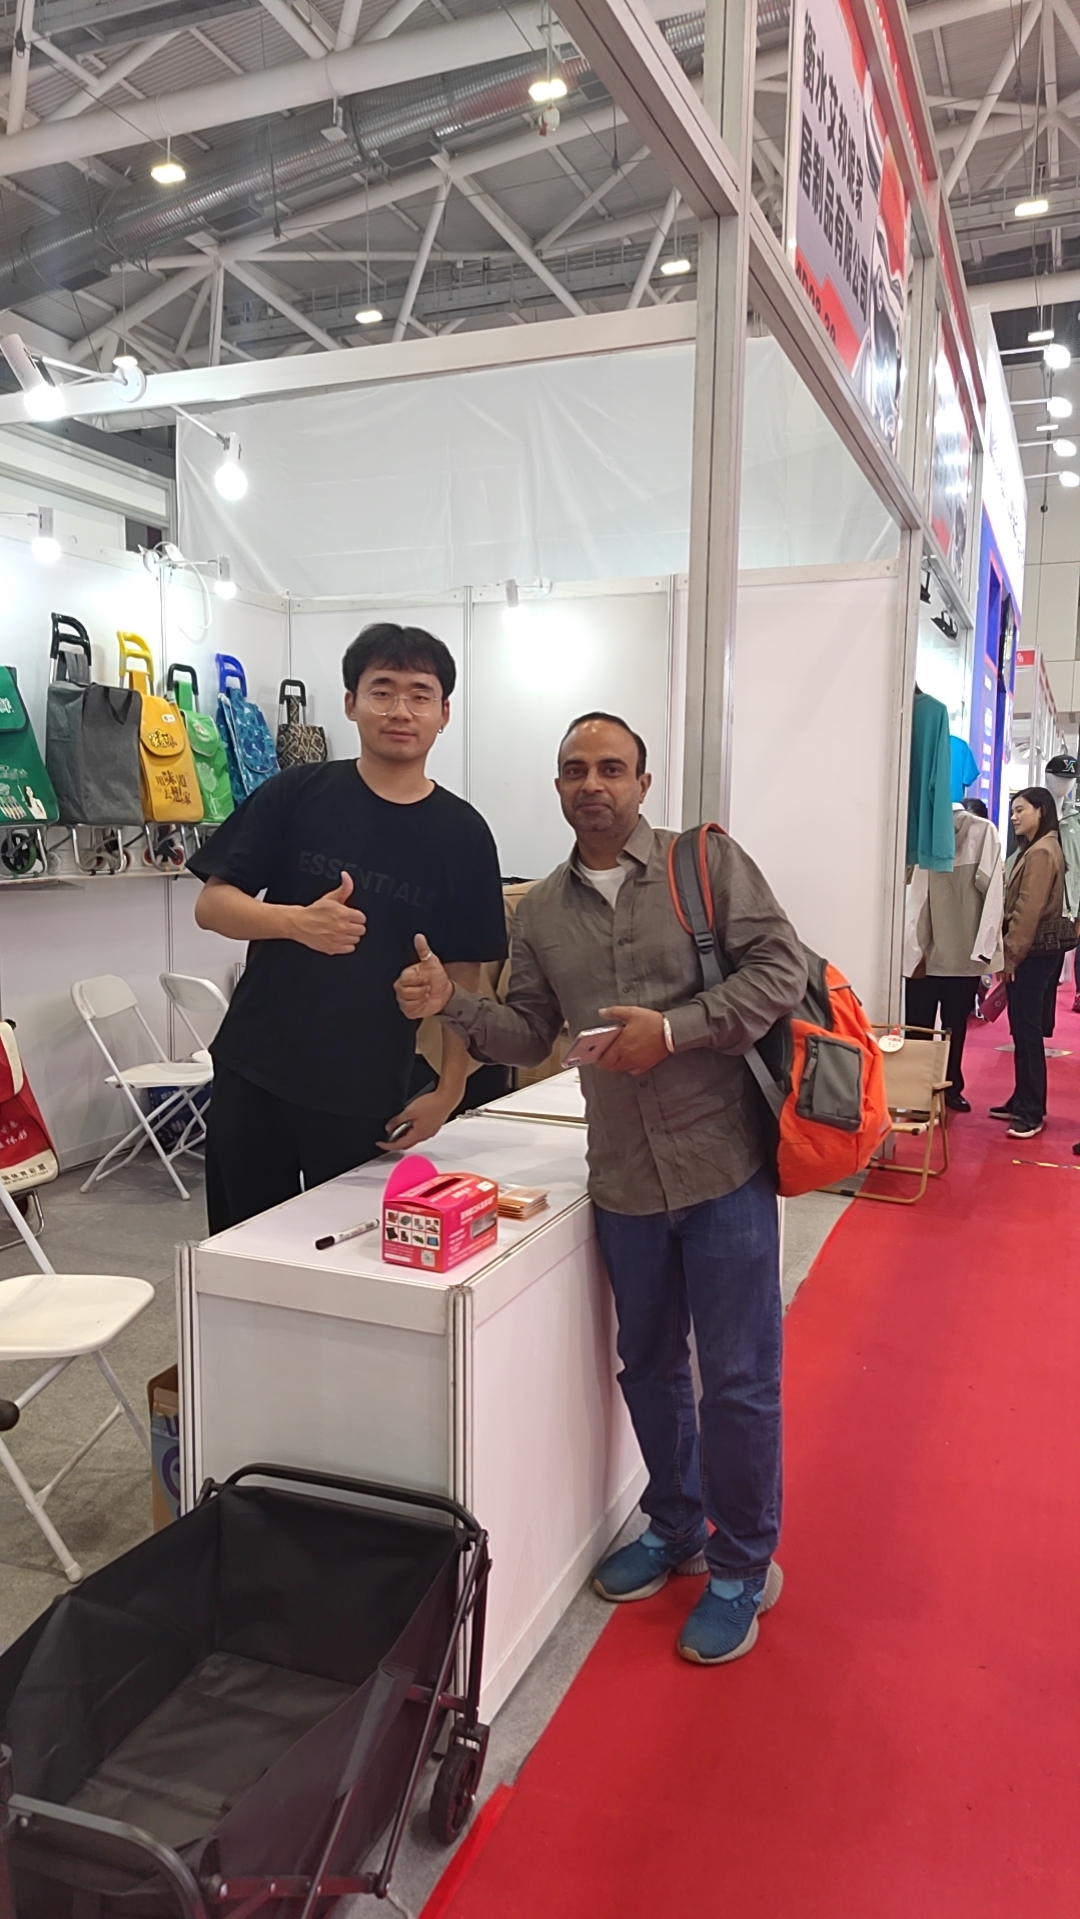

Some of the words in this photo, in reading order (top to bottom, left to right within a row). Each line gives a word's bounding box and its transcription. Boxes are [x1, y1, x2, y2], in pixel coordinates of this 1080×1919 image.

[799, 112, 869, 322] 居制品有限公司
